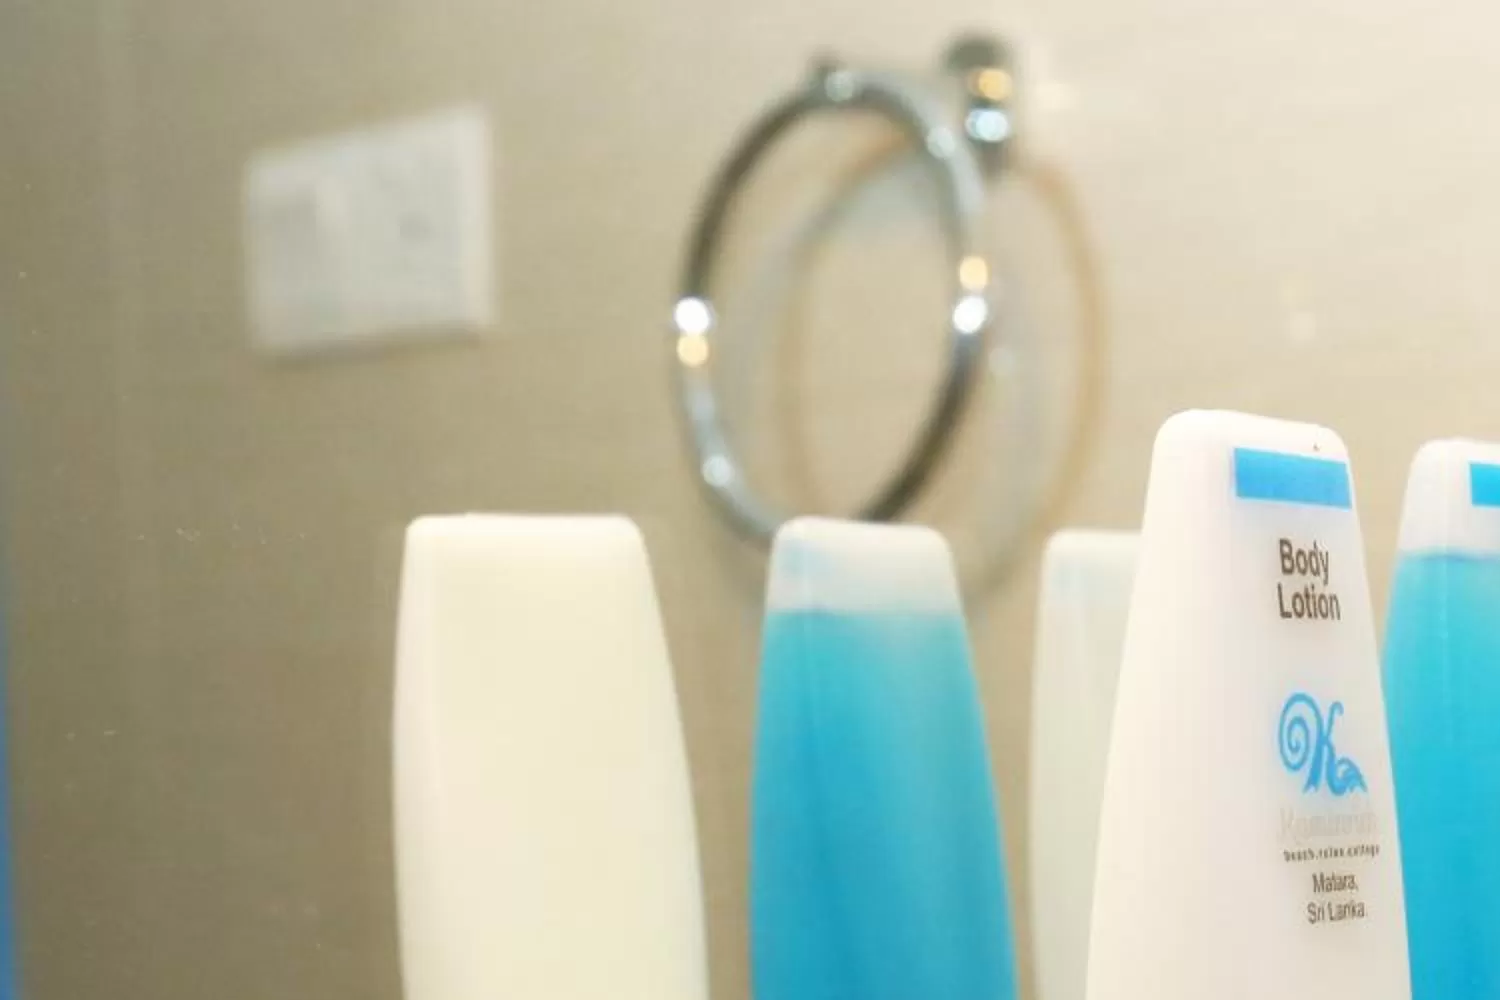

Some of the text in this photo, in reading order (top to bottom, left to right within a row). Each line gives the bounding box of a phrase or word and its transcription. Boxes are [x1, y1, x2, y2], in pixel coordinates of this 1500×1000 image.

[1279, 538, 1329, 586] Body
[1277, 582, 1341, 621] Lotion
[1307, 902, 1325, 925] Sri
